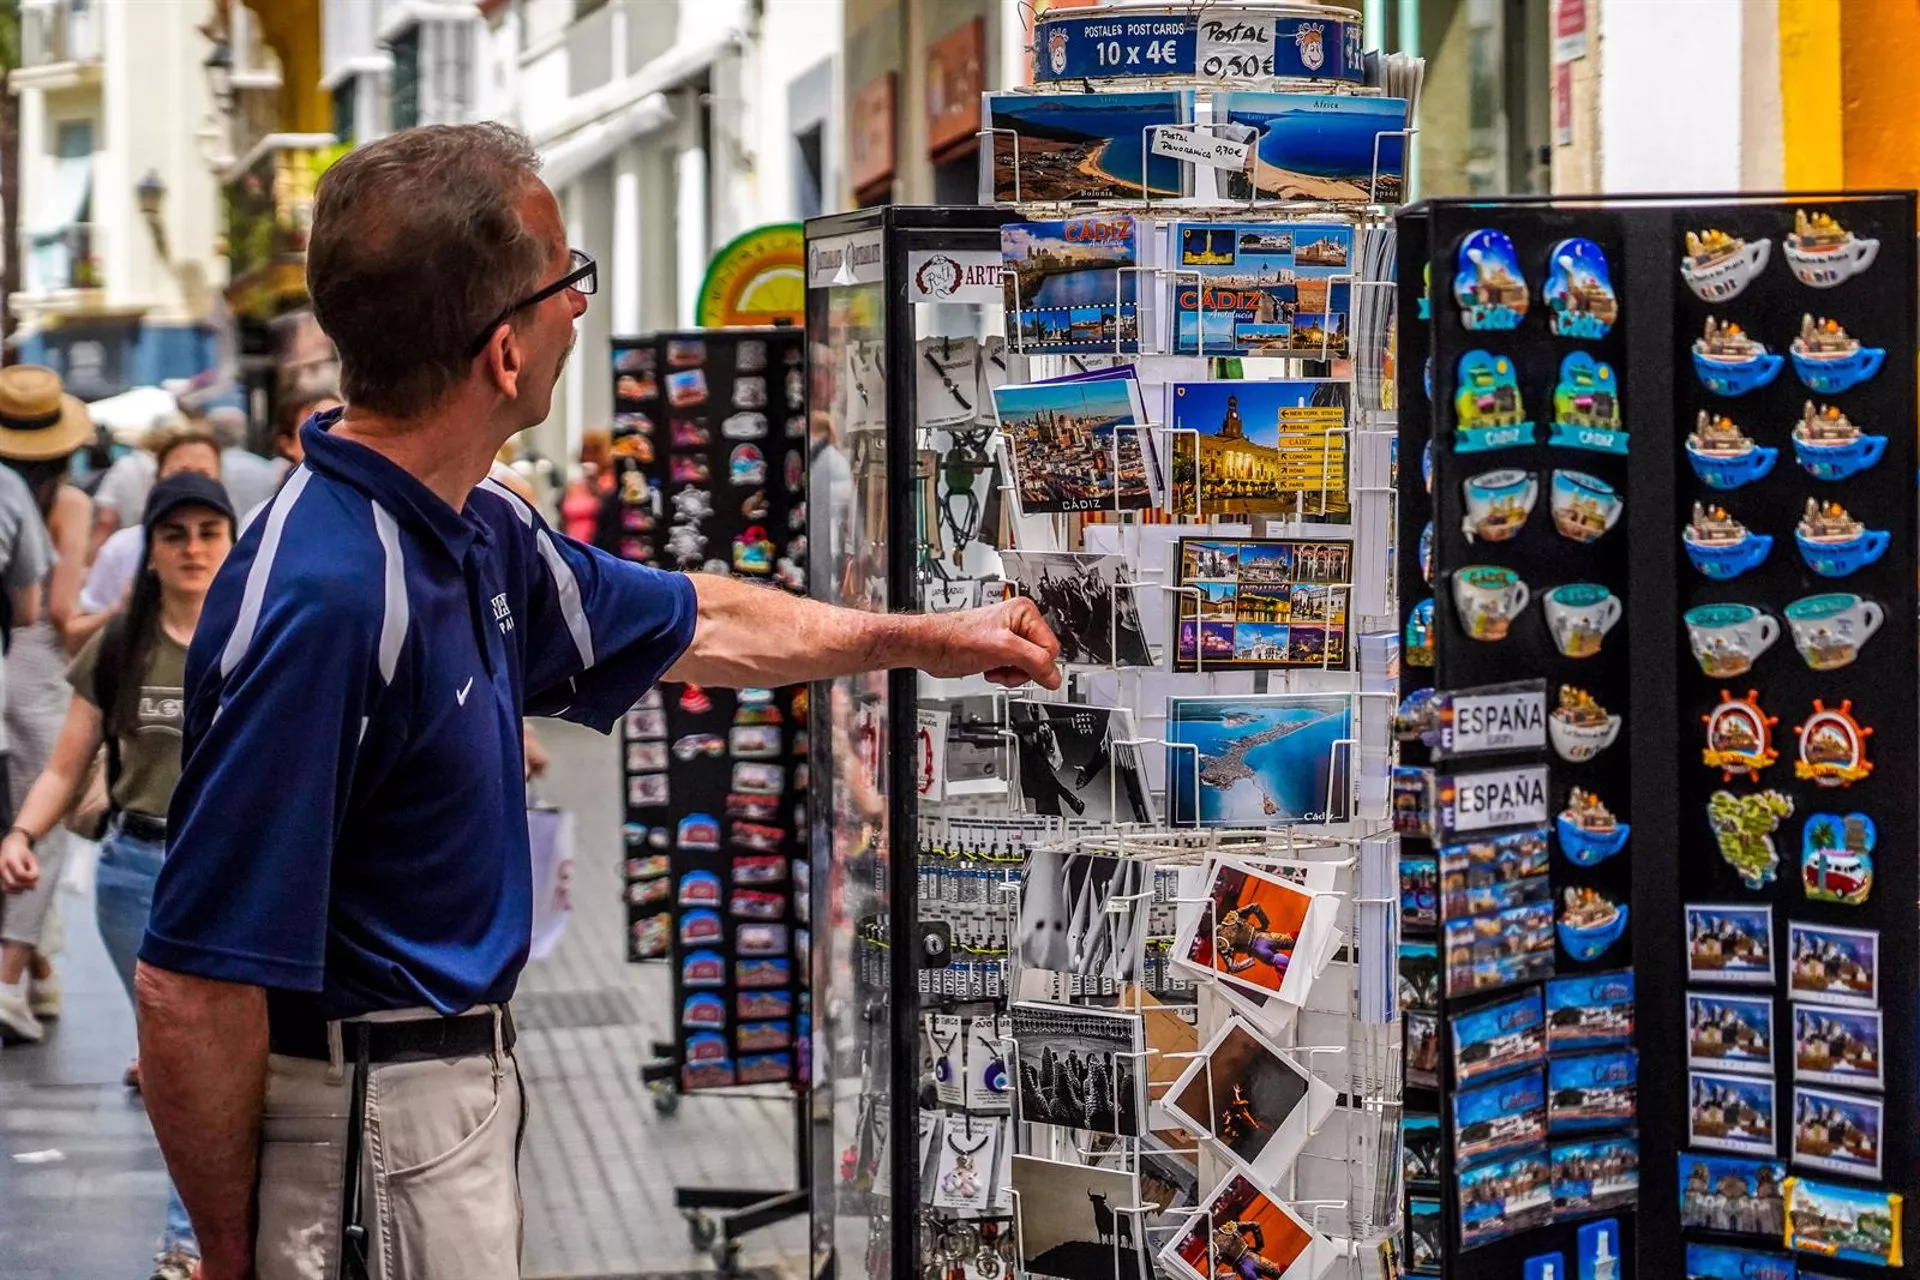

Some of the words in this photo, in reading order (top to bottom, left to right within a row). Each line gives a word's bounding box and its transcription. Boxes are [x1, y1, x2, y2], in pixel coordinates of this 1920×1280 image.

[1084, 24, 1122, 38] POSTALES
[1127, 24, 1151, 36] POST
[1153, 23, 1184, 35] CARDS
[1096, 41, 1121, 66] 10
[1126, 45, 1140, 65] x
[1146, 40, 1177, 64] 4€
[1203, 55, 1274, 80] 0,50€
[1215, 145, 1243, 158] 0,70€
[1065, 219, 1131, 243] CÁDIZ
[1180, 288, 1261, 310] CÁDIZ
[1062, 497, 1101, 511] CÁDIZ
[1458, 698, 1543, 735] ESPAÑA
[1459, 775, 1544, 813] ESPAÑA
[944, 969, 954, 993] OSCAR
[957, 971, 966, 995] PABLO
[972, 972, 980, 995] PACO
[987, 971, 998, 996] PALOMA
[975, 1020, 992, 1029] OJO
